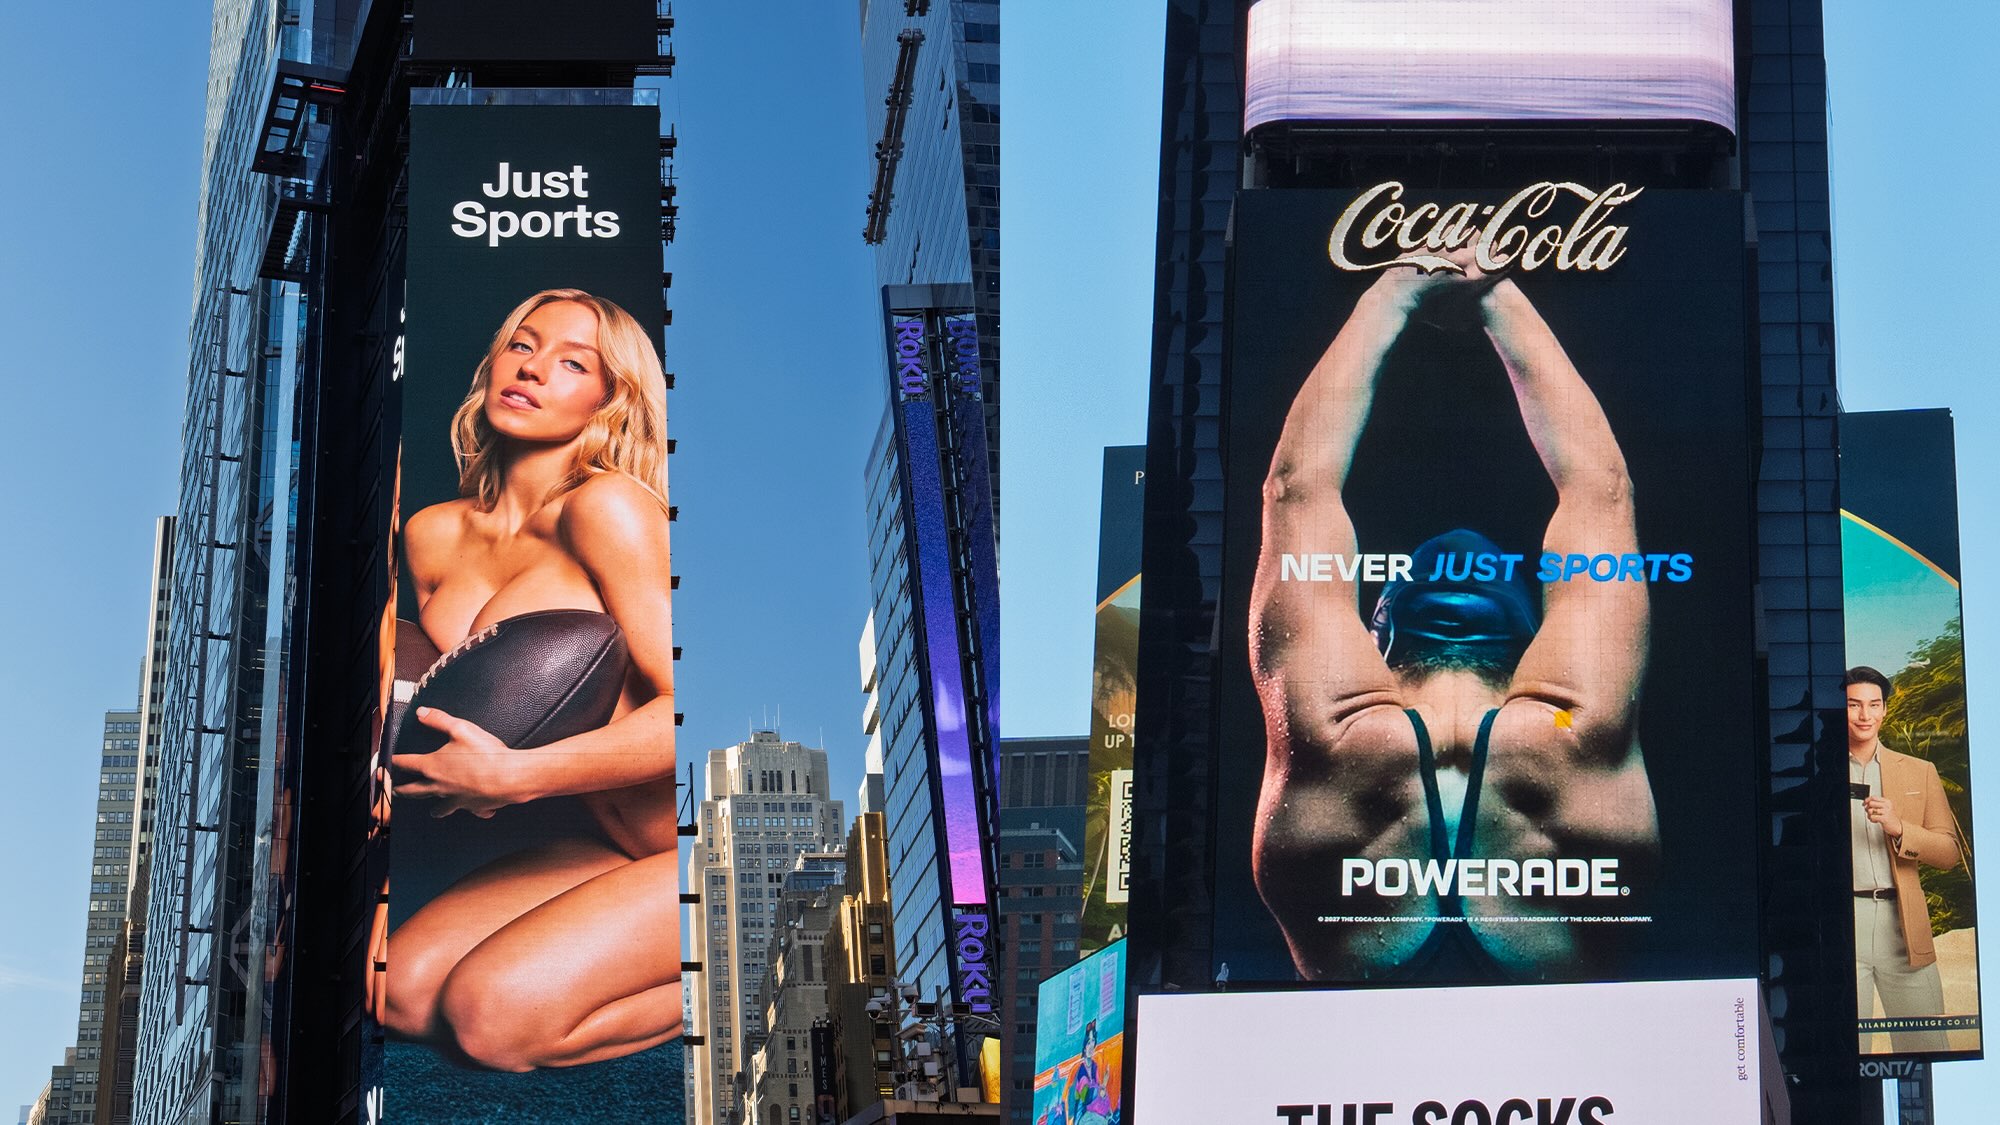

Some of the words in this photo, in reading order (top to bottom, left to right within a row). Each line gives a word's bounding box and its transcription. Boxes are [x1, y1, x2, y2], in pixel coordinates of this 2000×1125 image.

[482, 162, 589, 198] Just
[451, 200, 621, 247] Sports
[1329, 180, 1645, 277] Coca-Cola
[896, 321, 924, 395] ROKU
[1280, 553, 1414, 582] NEVER
[1428, 551, 1524, 582] JUST
[1536, 553, 1694, 582] SPORTS
[1104, 734, 1125, 749] UP
[956, 914, 992, 1013] ROKU
[1734, 997, 1745, 1061] comfortable
[820, 1033, 828, 1090] TIMES
[1738, 1064, 1749, 1081] get
